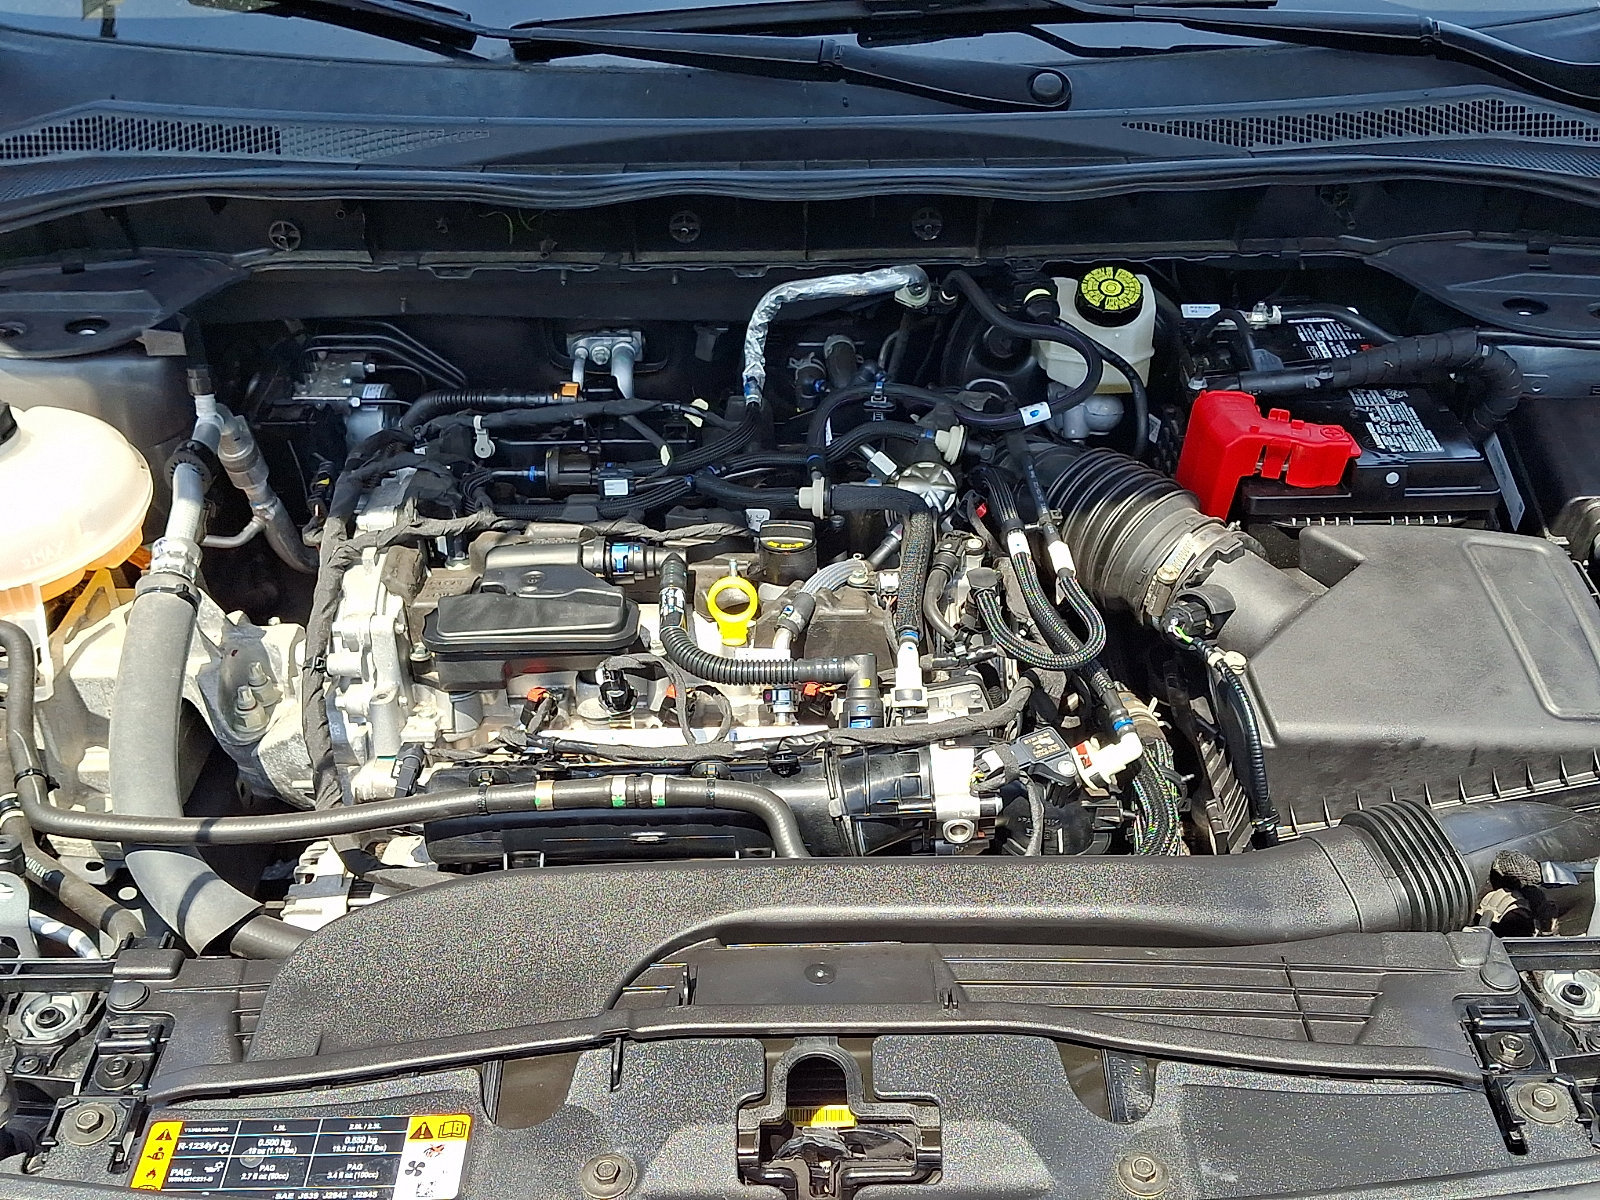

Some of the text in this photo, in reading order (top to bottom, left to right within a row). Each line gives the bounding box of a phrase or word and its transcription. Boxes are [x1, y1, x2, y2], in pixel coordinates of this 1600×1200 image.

[257, 1138, 292, 1148] 0.500 kg
[366, 1135, 379, 1145] kg
[177, 1141, 219, 1152] R-1234yf
[259, 1164, 276, 1172] PAG
[346, 1163, 364, 1171] PAG
[170, 1168, 193, 1176] PAG
[275, 1192, 294, 1200] SAE
